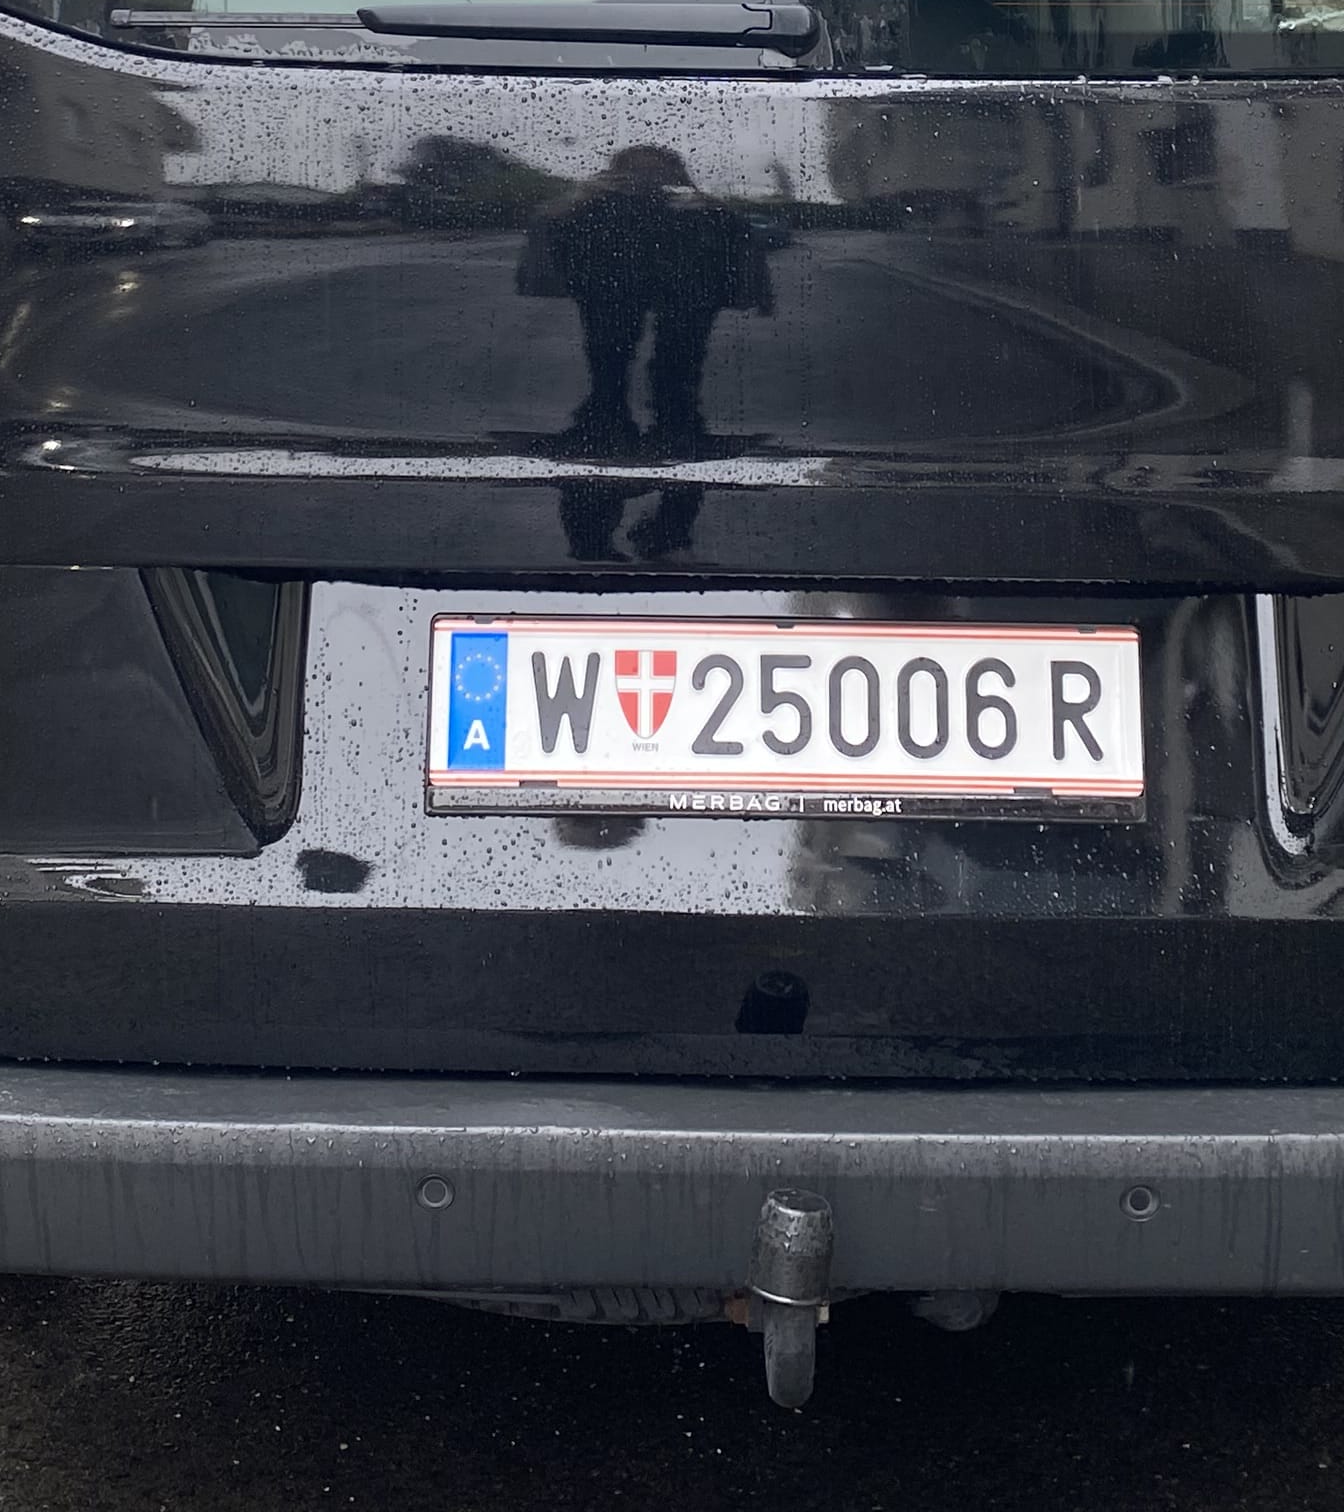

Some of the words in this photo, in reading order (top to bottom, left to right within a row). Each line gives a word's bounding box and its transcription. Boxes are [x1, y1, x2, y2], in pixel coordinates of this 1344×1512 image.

[531, 651, 601, 754] W
[691, 653, 1017, 760] 25006
[1049, 660, 1104, 761] R
[463, 719, 490, 750] A
[632, 742, 659, 752] WIEN
[669, 794, 780, 812] MERBAG
[823, 797, 902, 816] merbag.at
